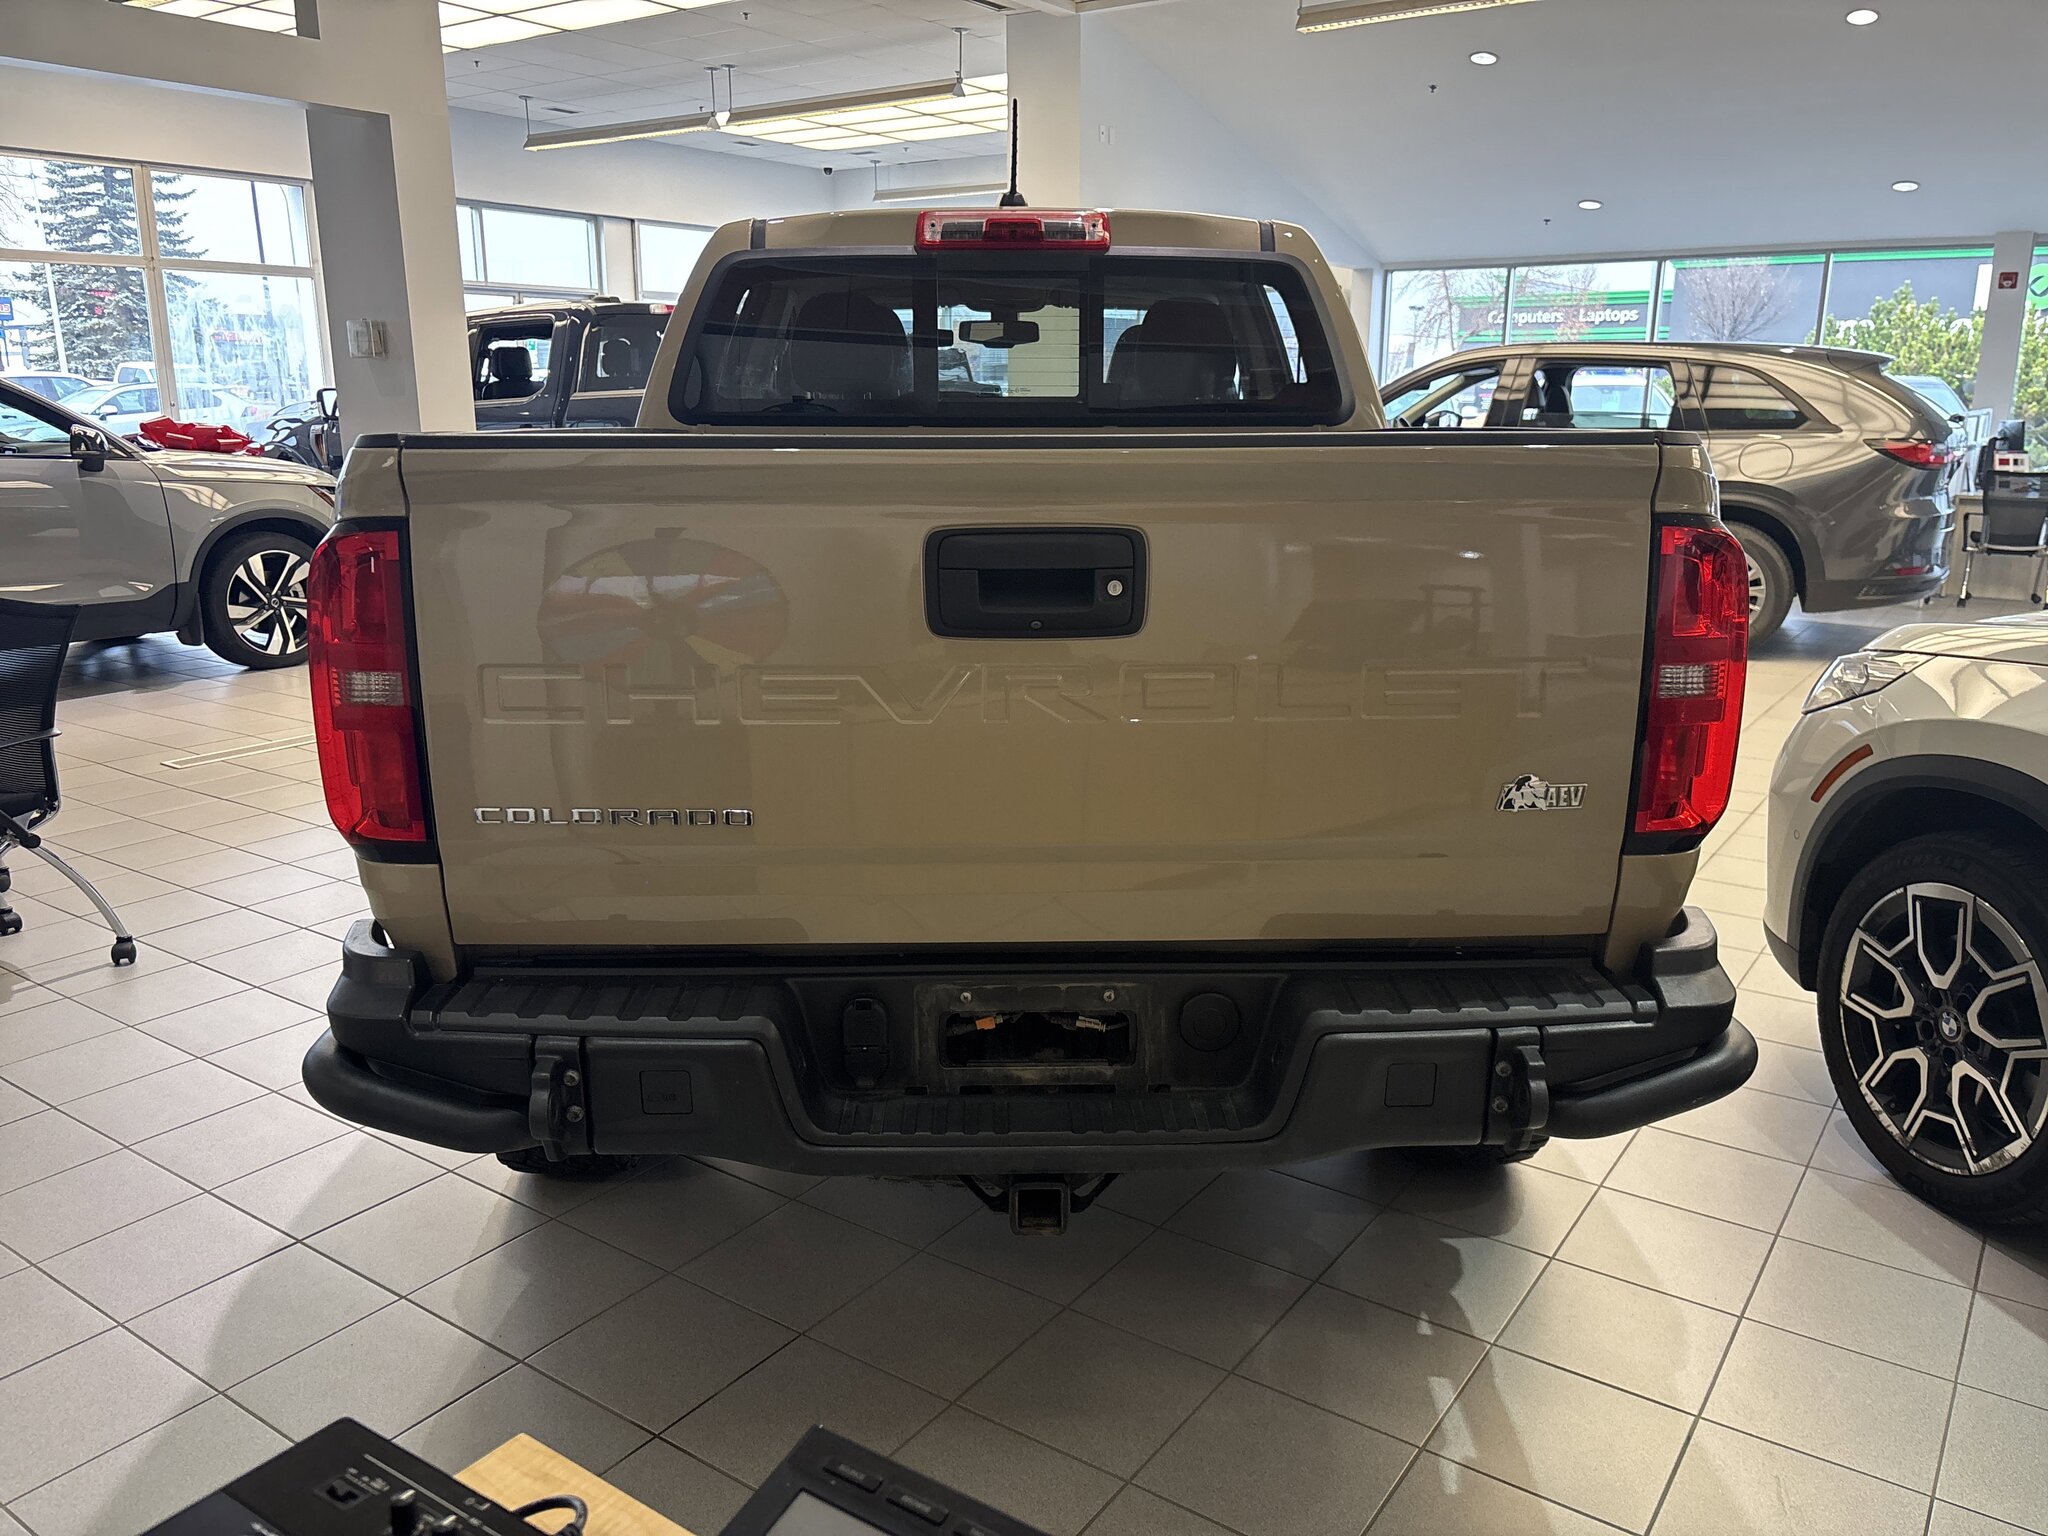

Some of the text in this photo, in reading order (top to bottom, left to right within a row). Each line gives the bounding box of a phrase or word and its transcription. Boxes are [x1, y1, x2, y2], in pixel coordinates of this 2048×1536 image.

[1578, 308, 1640, 325] Laptops
[477, 658, 1589, 726] CHEVROLET
[1546, 786, 1584, 806] AEV
[473, 806, 754, 827] COLORADO
